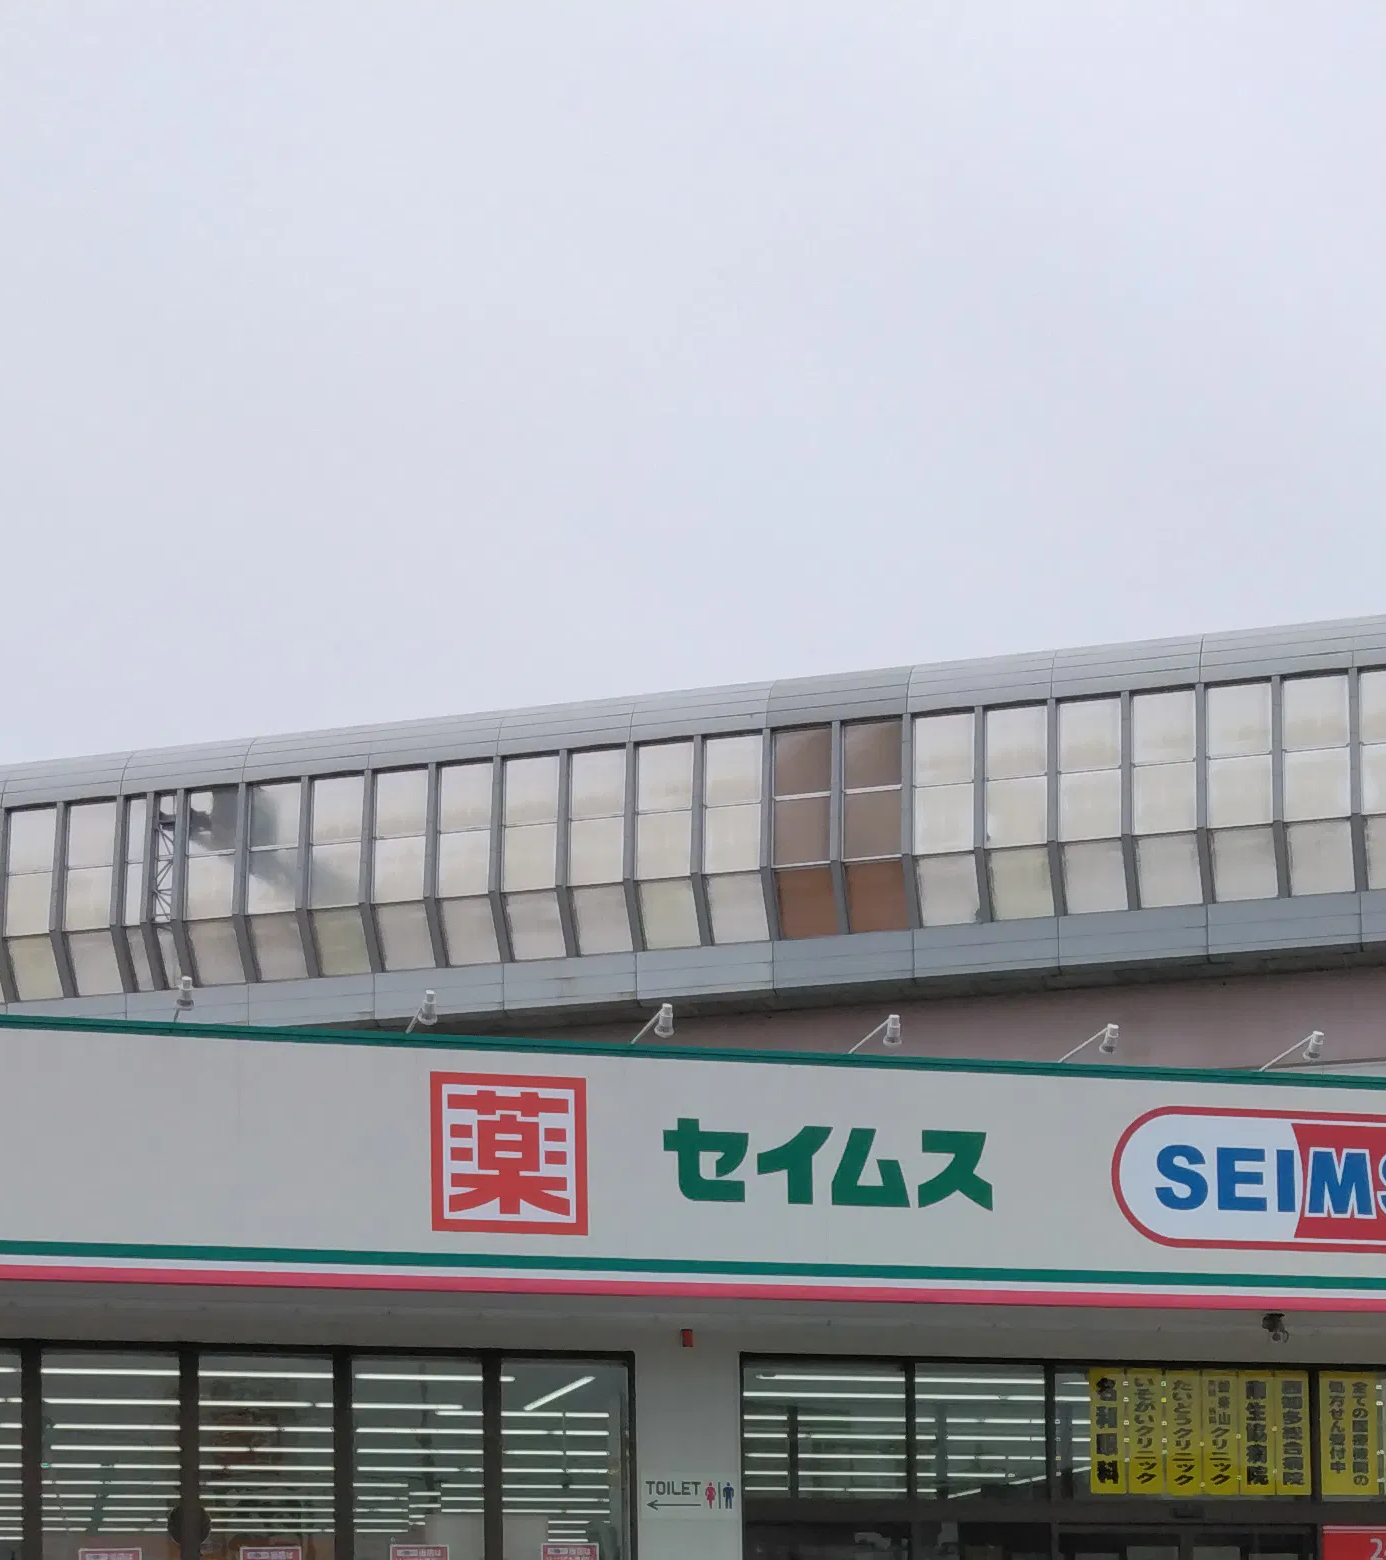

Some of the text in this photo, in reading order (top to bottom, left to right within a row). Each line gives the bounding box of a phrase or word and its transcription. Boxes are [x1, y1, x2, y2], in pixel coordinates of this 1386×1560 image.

[447, 1091, 571, 1214] 薬
[663, 1117, 993, 1211] セイムス
[645, 1481, 701, 1496] TOILET
